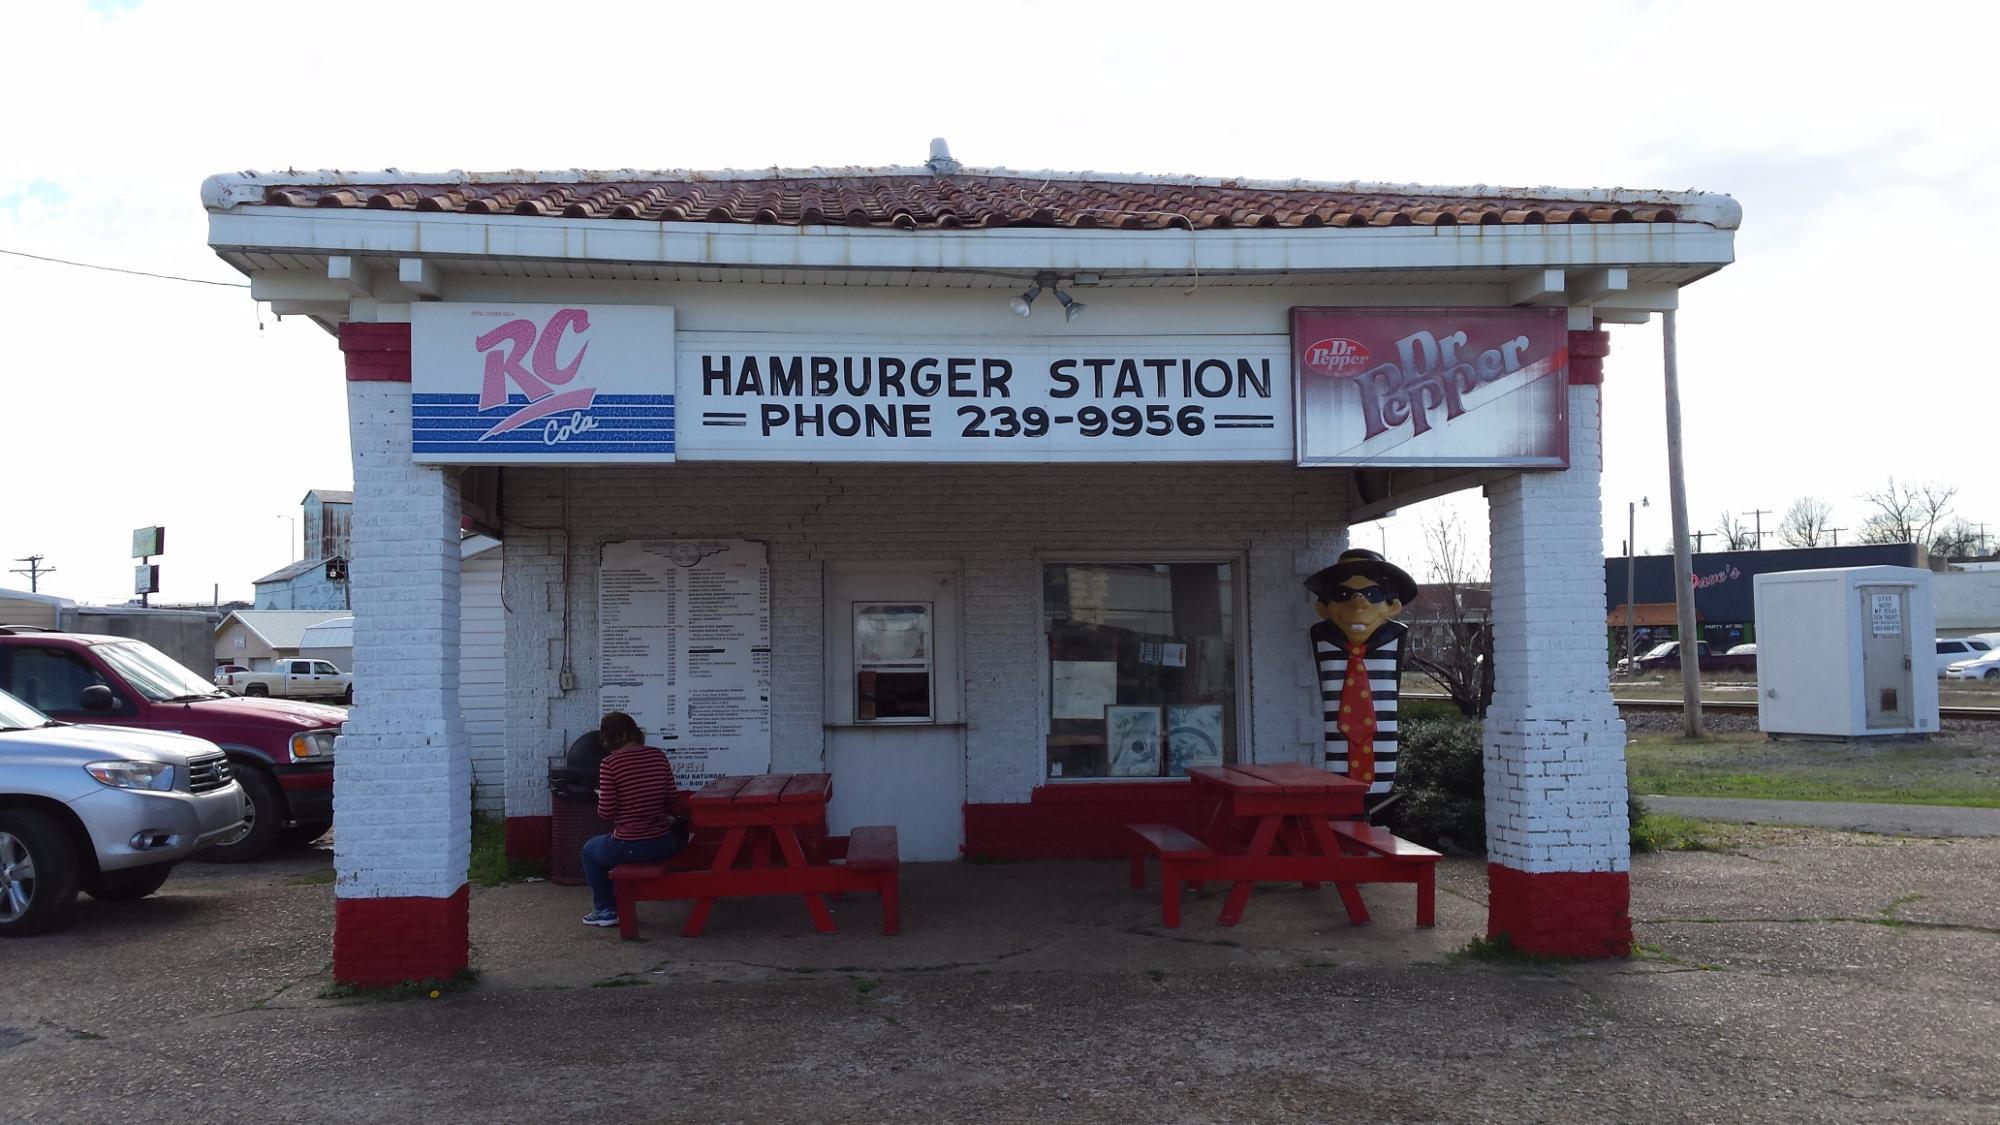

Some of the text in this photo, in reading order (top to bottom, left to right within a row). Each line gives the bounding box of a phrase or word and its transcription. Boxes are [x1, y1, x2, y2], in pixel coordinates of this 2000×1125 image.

[475, 308, 590, 412] RC
[1311, 348, 1369, 371] Pepper
[1330, 340, 1356, 356] Dr
[1395, 329, 1468, 381] Dr
[702, 355, 1271, 398] HAMBURGER STATION
[1352, 335, 1530, 441] Pepper
[544, 411, 599, 445] Cola
[761, 403, 1206, 438] PHONE 239-9956
